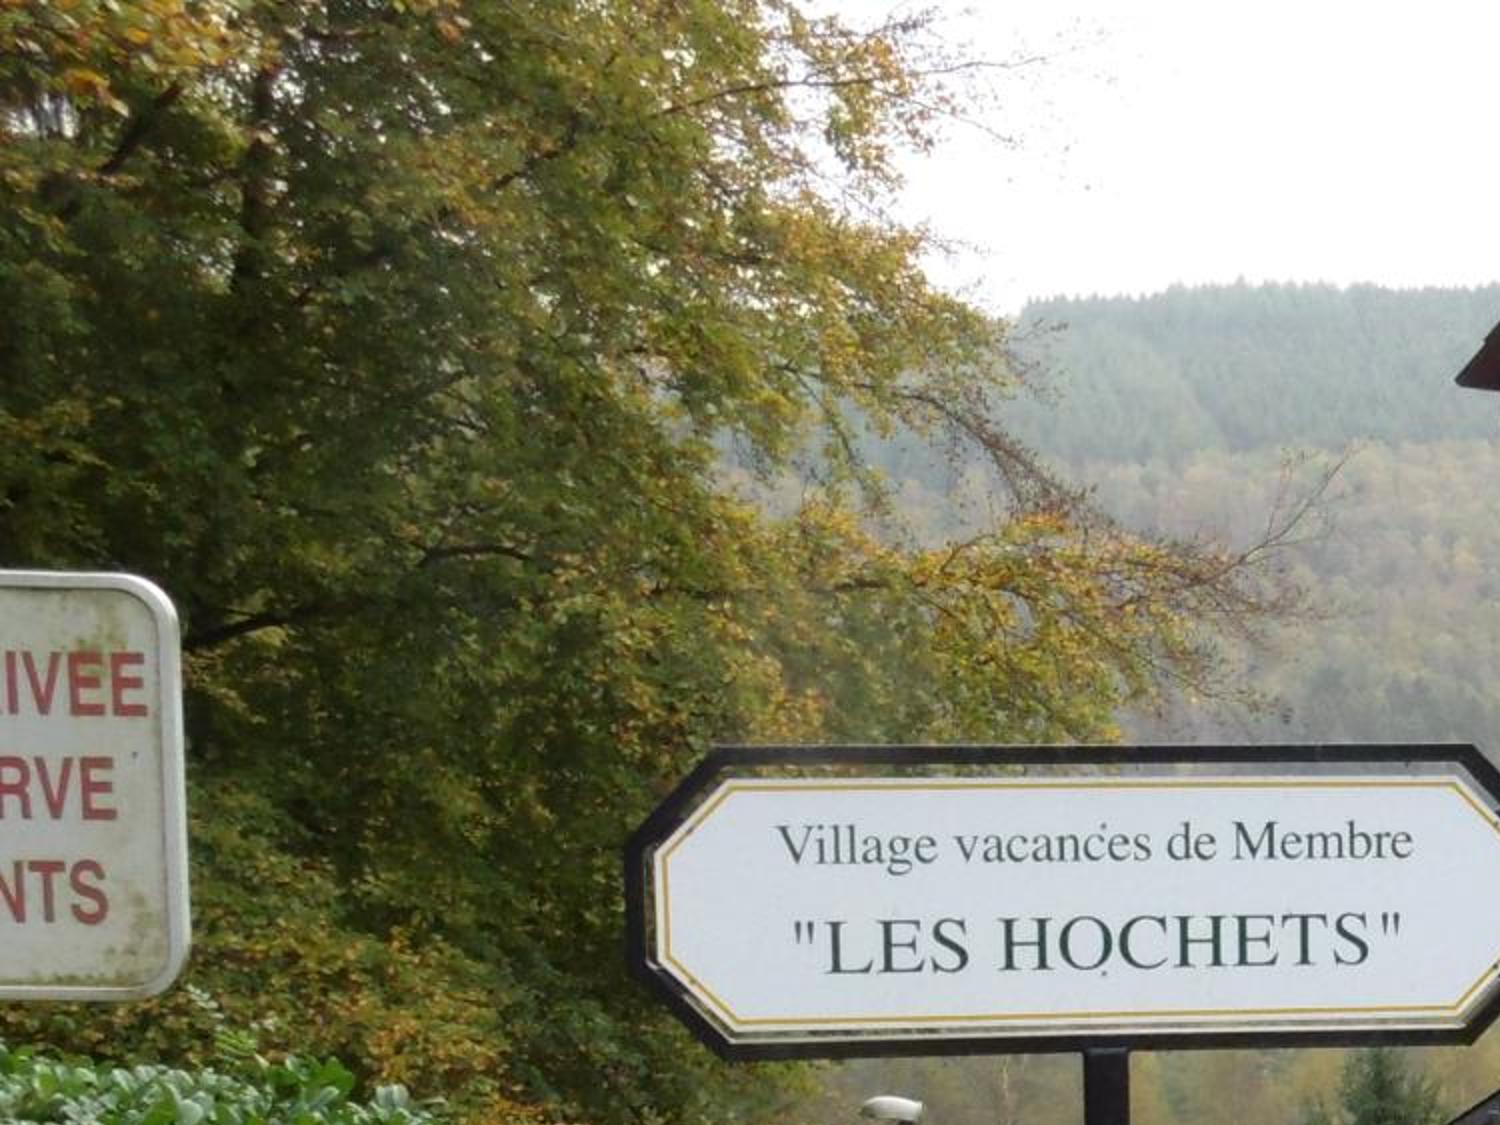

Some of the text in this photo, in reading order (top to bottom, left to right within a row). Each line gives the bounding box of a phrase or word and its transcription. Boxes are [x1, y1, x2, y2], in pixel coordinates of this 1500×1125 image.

[777, 820, 1413, 875] Village vacances de Membre
[794, 912, 1401, 975] "LES HOCHETS"
